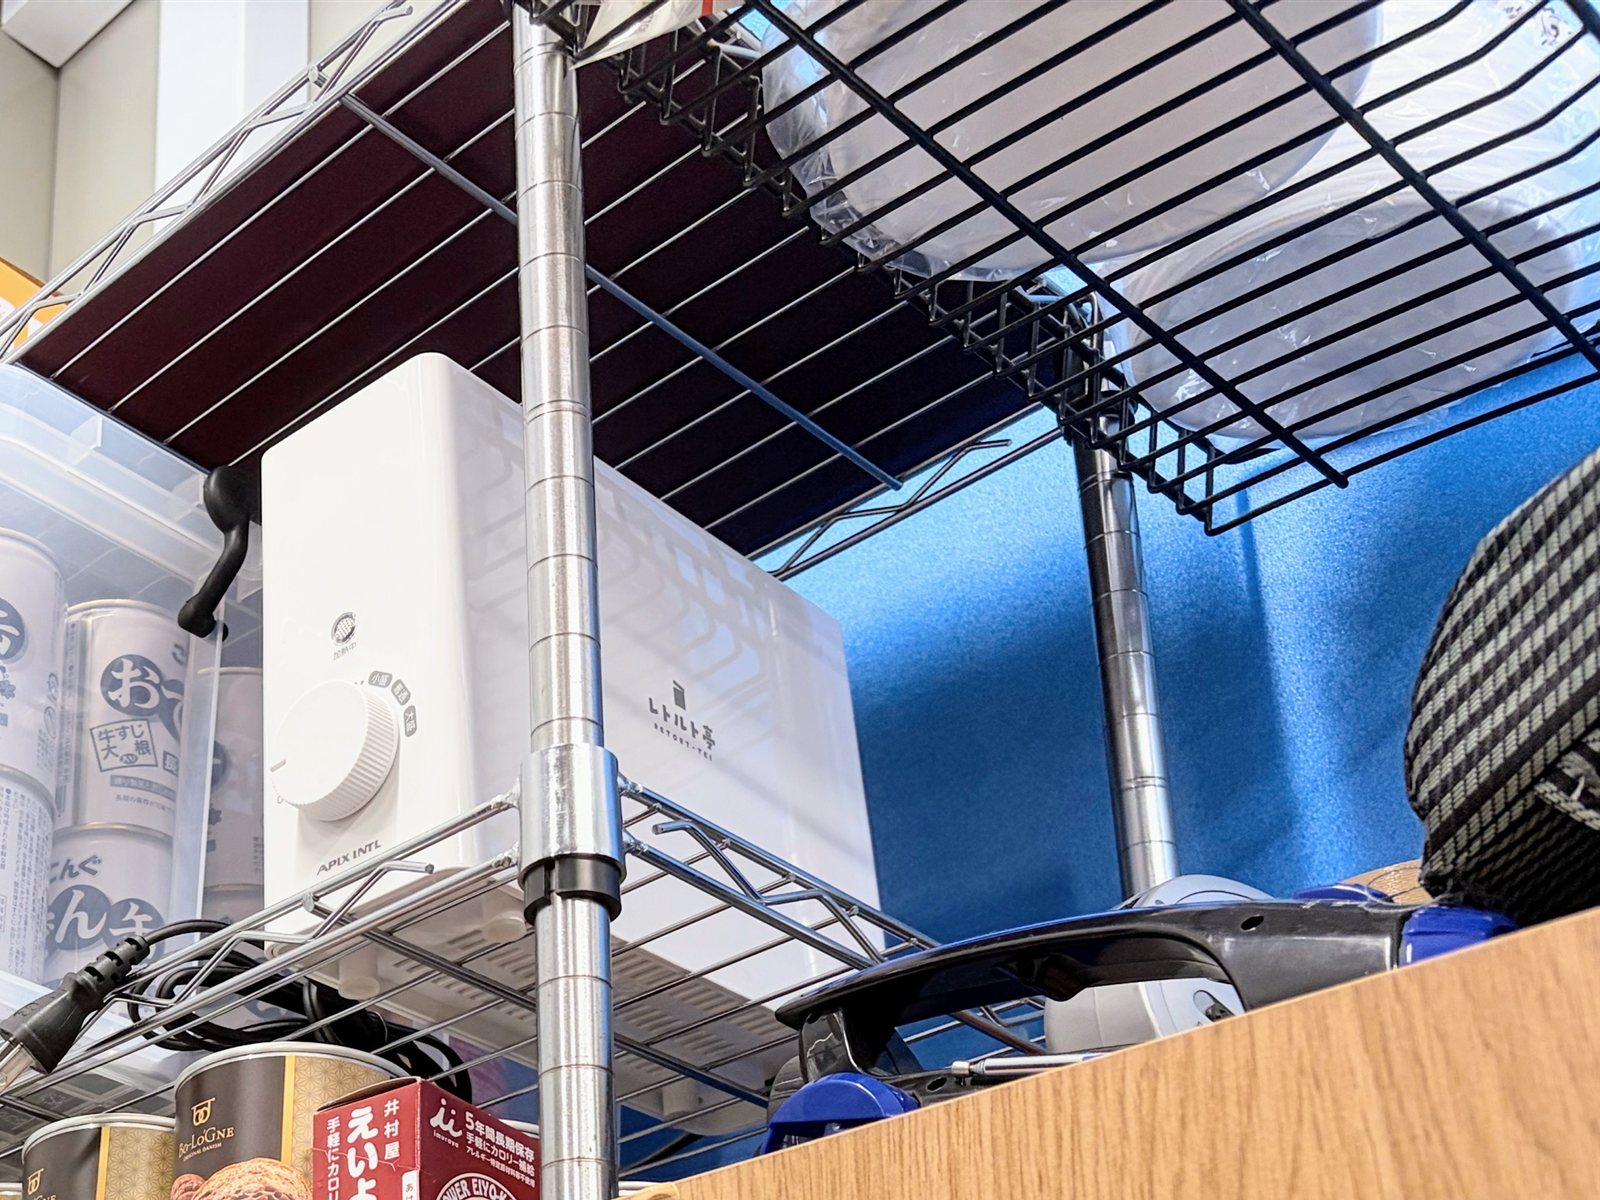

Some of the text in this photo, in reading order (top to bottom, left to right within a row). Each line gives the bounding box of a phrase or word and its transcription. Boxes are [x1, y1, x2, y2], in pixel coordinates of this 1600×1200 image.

[97, 723, 145, 744] 牛すじ
[648, 696, 716, 751] レトルト亭
[317, 840, 382, 876] APIX INTL
[383, 1099, 400, 1161] 井村屋
[465, 1111, 535, 1163] 5年間長期保存
[466, 1131, 535, 1177] 手軽にカロリー補給
